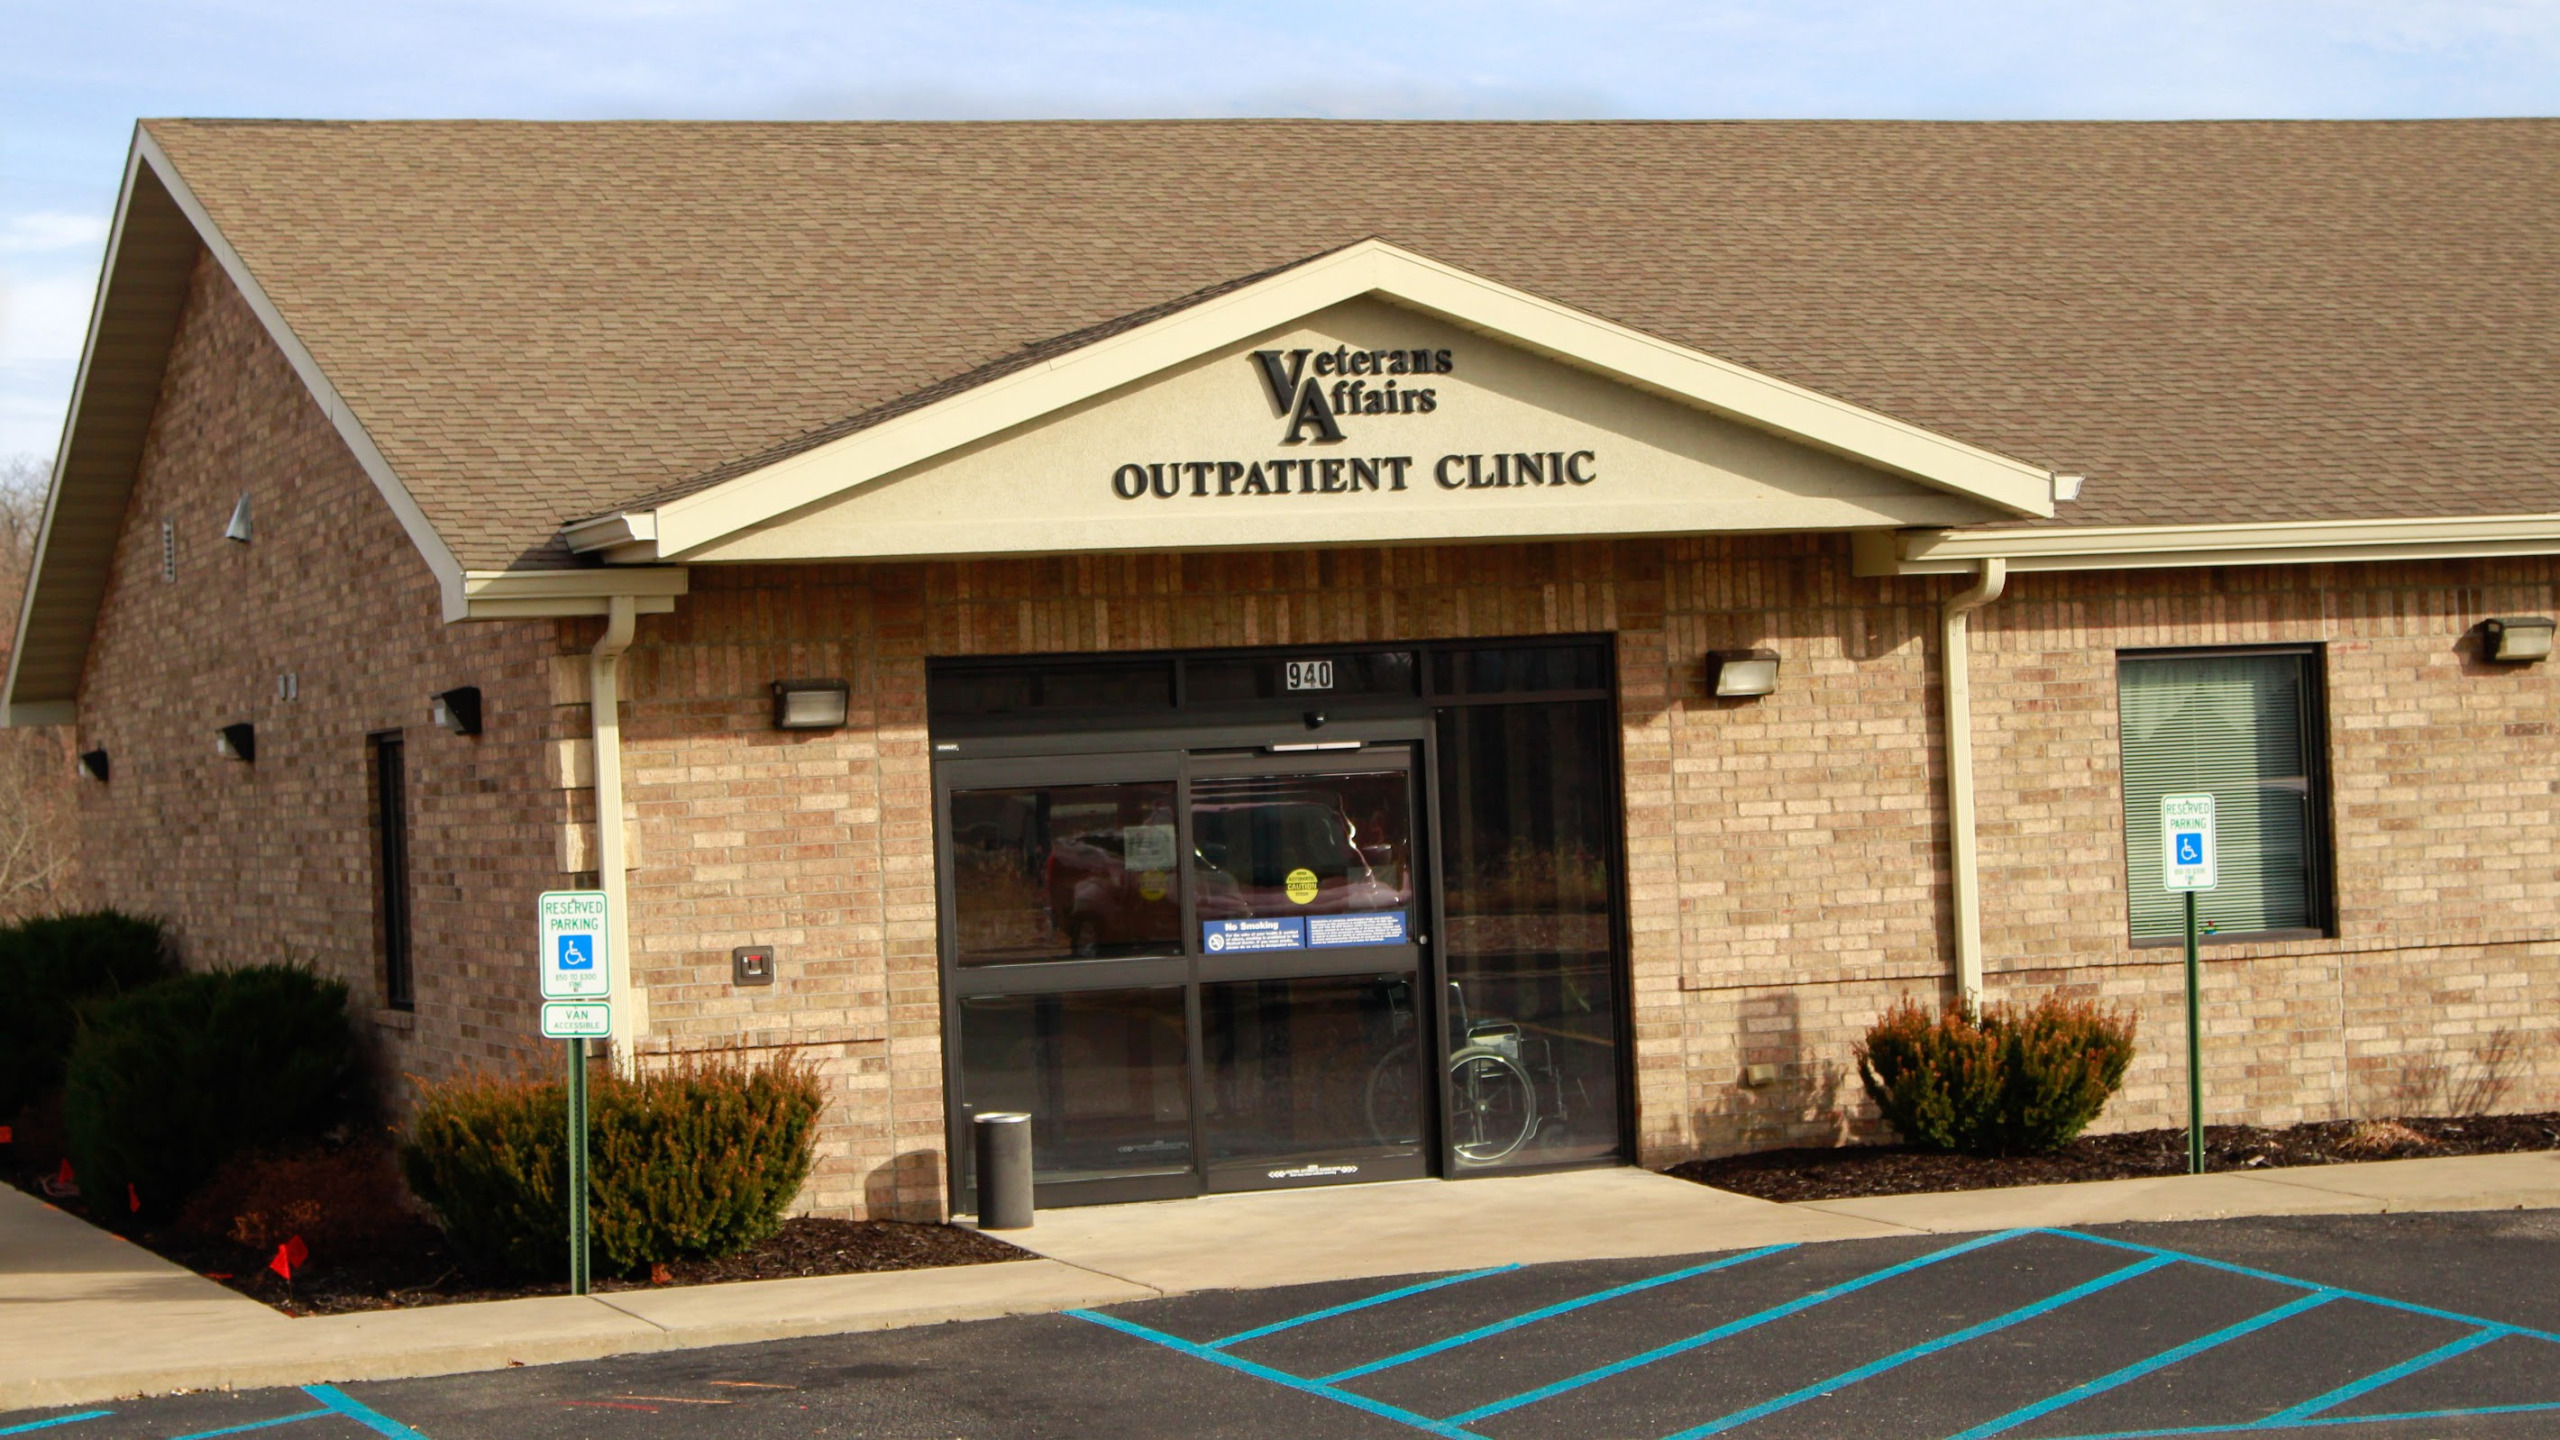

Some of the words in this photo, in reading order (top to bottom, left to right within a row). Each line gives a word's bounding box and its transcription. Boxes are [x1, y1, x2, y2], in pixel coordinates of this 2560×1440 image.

[1253, 346, 1454, 416] Veterans
[1282, 377, 1438, 444] Affairs
[1113, 456, 1413, 499] OUTPATIENT
[1435, 450, 1597, 489] CLINIC
[1289, 662, 1331, 689] 940
[2166, 802, 2210, 815] RESERVED
[2170, 818, 2207, 829] PARKING
[1287, 882, 1317, 890] CAUTION
[545, 901, 603, 915] RESERVED
[550, 918, 598, 931] PARKING
[1224, 922, 1238, 931] No
[1240, 921, 1279, 930] Smoking
[565, 1010, 589, 1020] VAN
[554, 1021, 600, 1030] ACCESSIBLE
